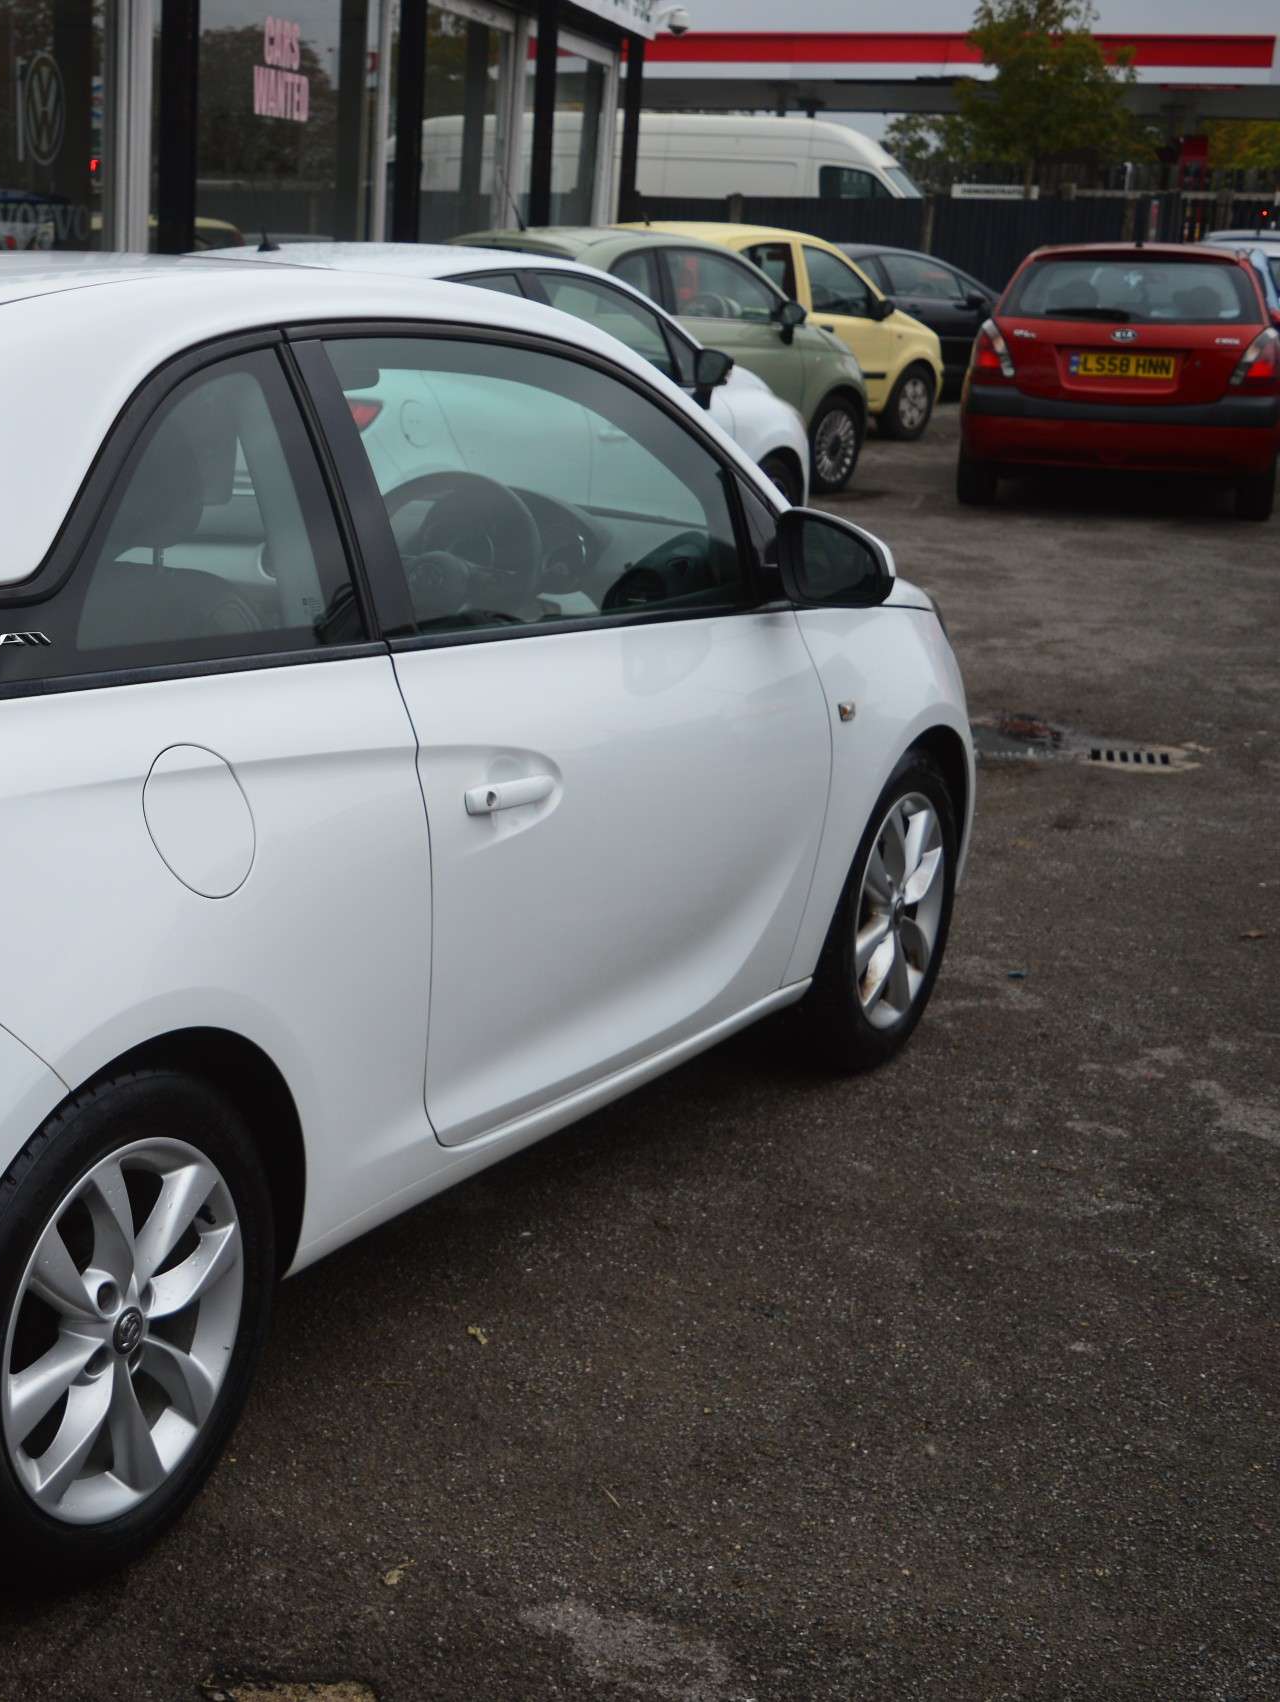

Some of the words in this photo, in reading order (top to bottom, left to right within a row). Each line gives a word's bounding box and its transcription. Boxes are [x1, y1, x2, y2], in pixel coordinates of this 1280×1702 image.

[263, 15, 301, 71] CARS
[253, 64, 310, 122] WANTED
[1083, 354, 1129, 374] LS58
[1135, 356, 1171, 375] HNN
